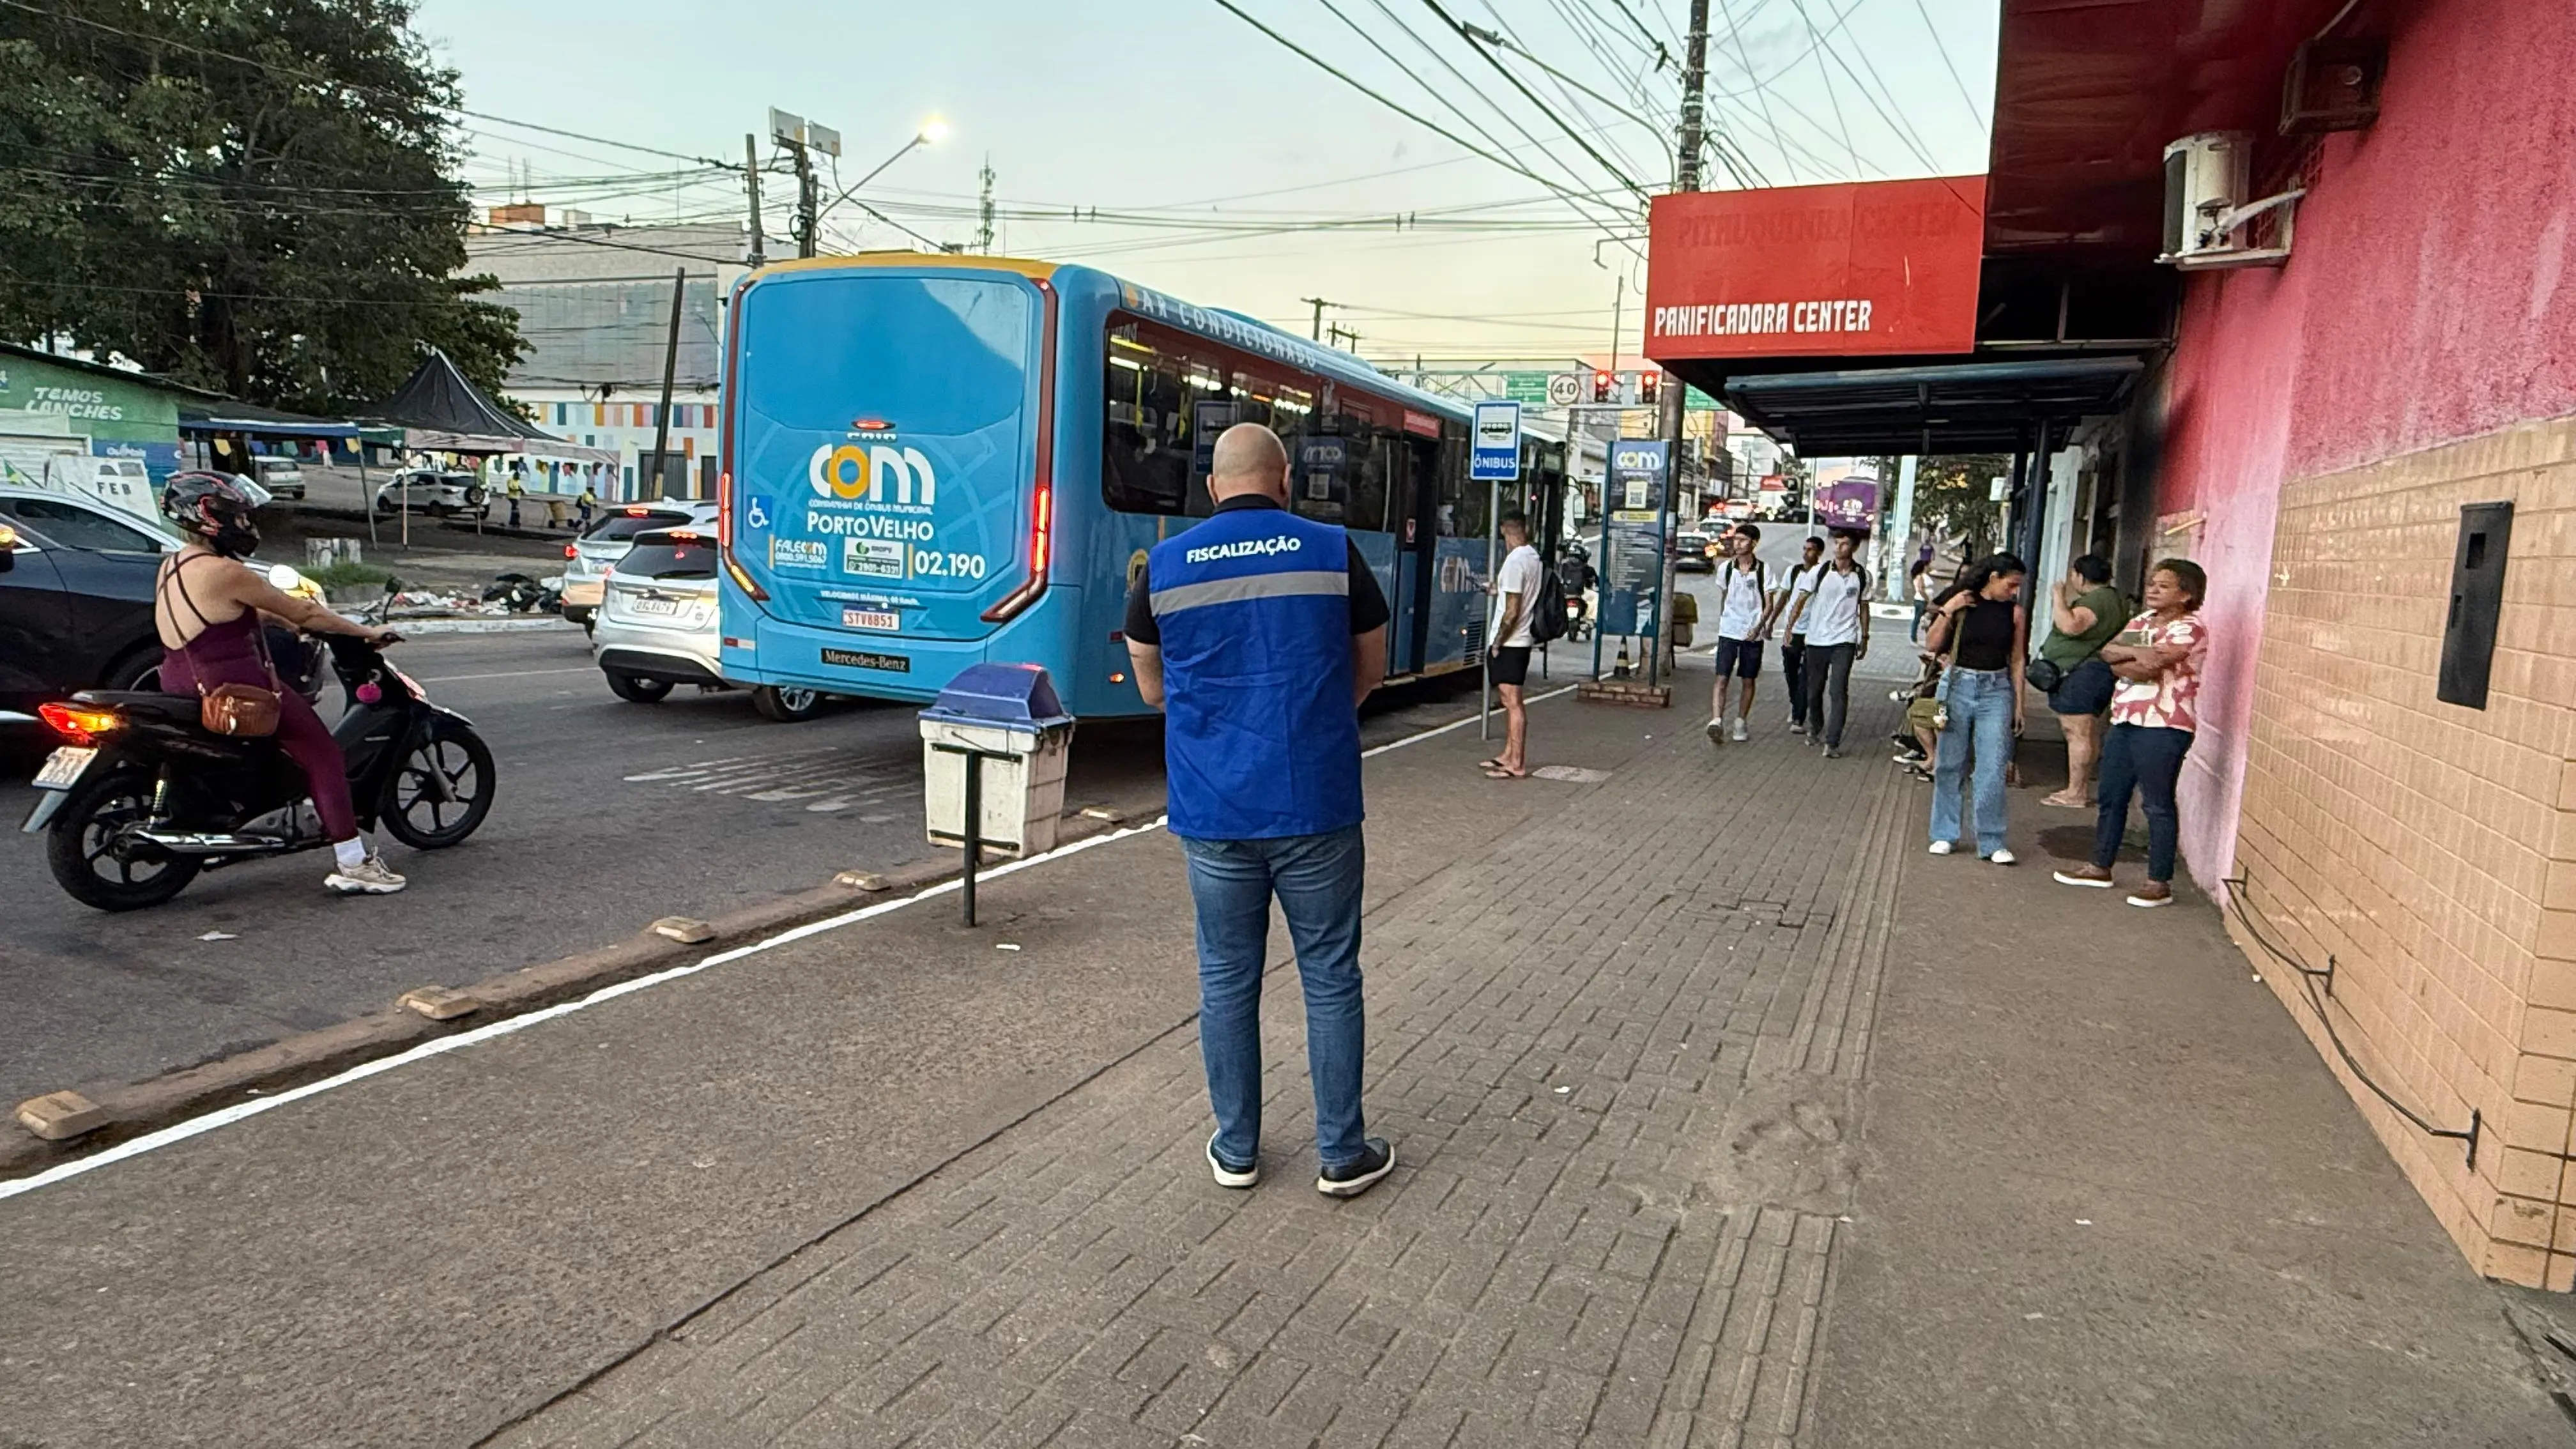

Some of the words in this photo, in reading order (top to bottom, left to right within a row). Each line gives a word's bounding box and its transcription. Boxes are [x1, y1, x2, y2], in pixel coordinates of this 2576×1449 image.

[1142, 289, 1167, 318] AR
[1653, 302, 1790, 337] PANIFICADORA
[1793, 300, 1872, 333] CENTER
[34, 387, 103, 404] TEMOS
[1554, 382, 1577, 395] 40
[25, 400, 123, 420] LANCHES
[1474, 452, 1516, 469] ÔNIBUS
[97, 482, 132, 495] FEB
[1186, 535, 1301, 564] FISCALIZAÇÃO
[915, 550, 985, 579] 02.190
[848, 612, 894, 628] STV8851
[825, 650, 907, 671] Mercedes-Benz
